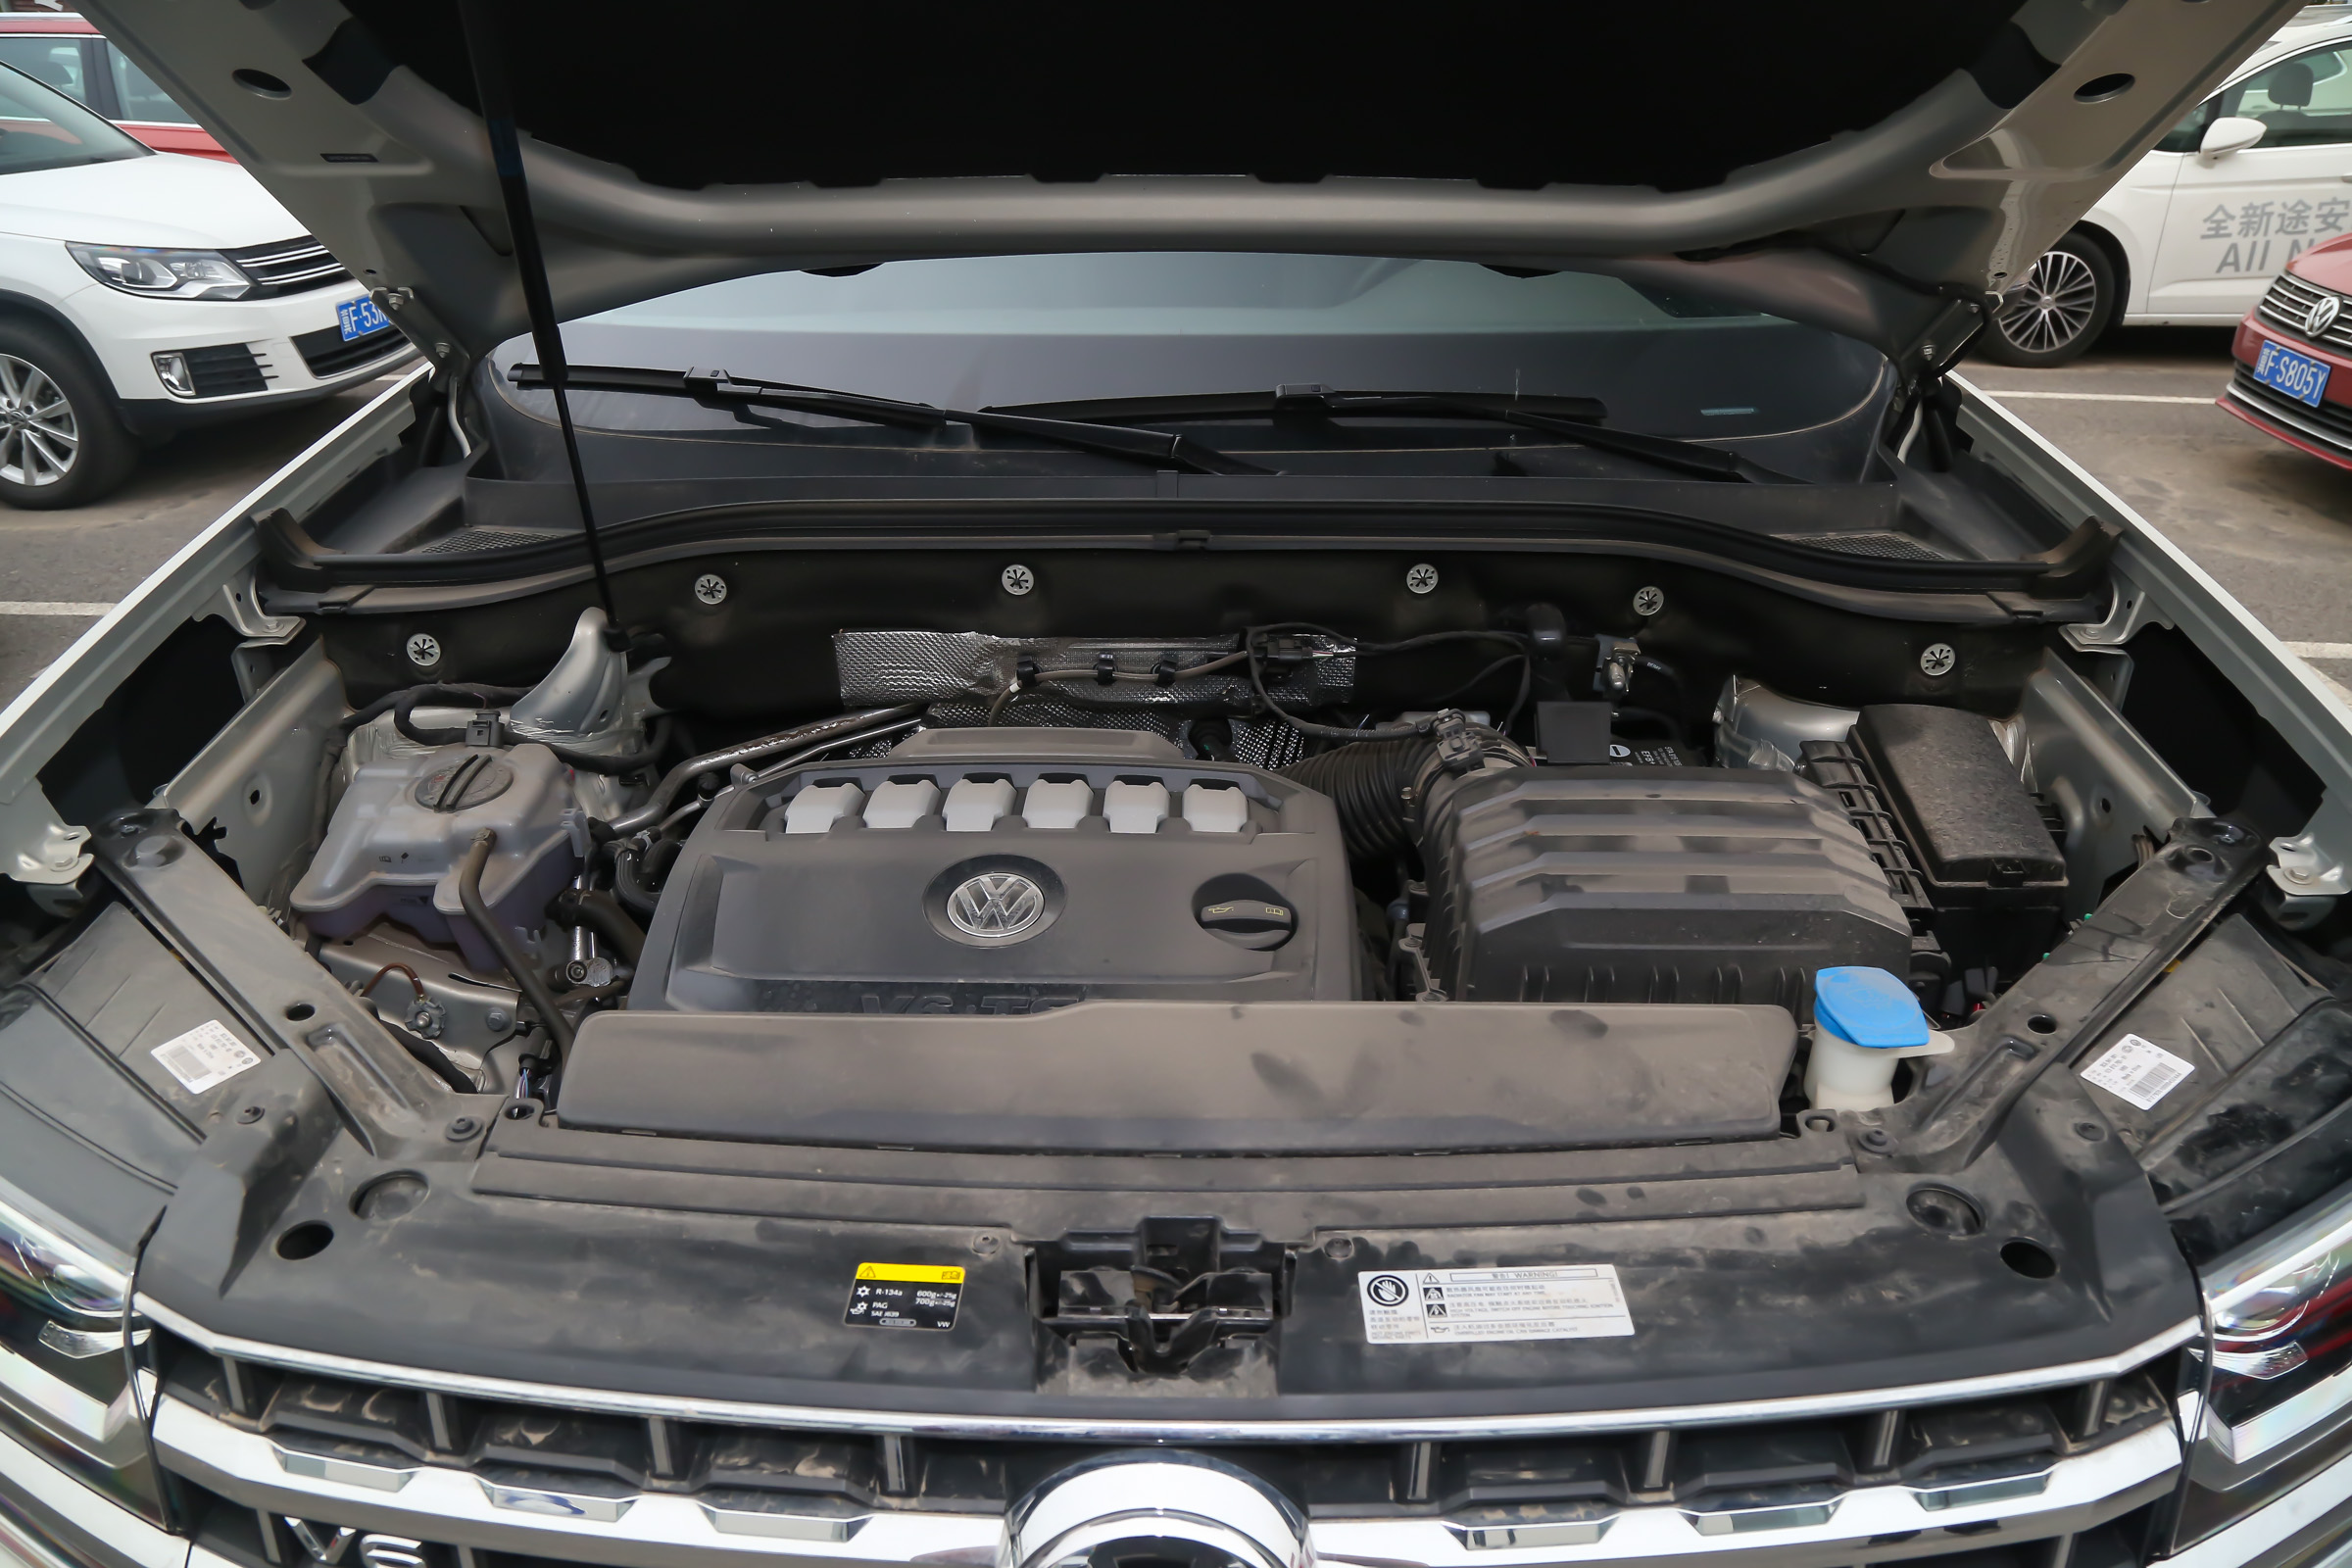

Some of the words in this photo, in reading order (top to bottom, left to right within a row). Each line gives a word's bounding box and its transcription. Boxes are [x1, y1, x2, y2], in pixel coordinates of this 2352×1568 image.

[2200, 197, 2350, 239] 全新途安
[2215, 240, 2271, 273] All
